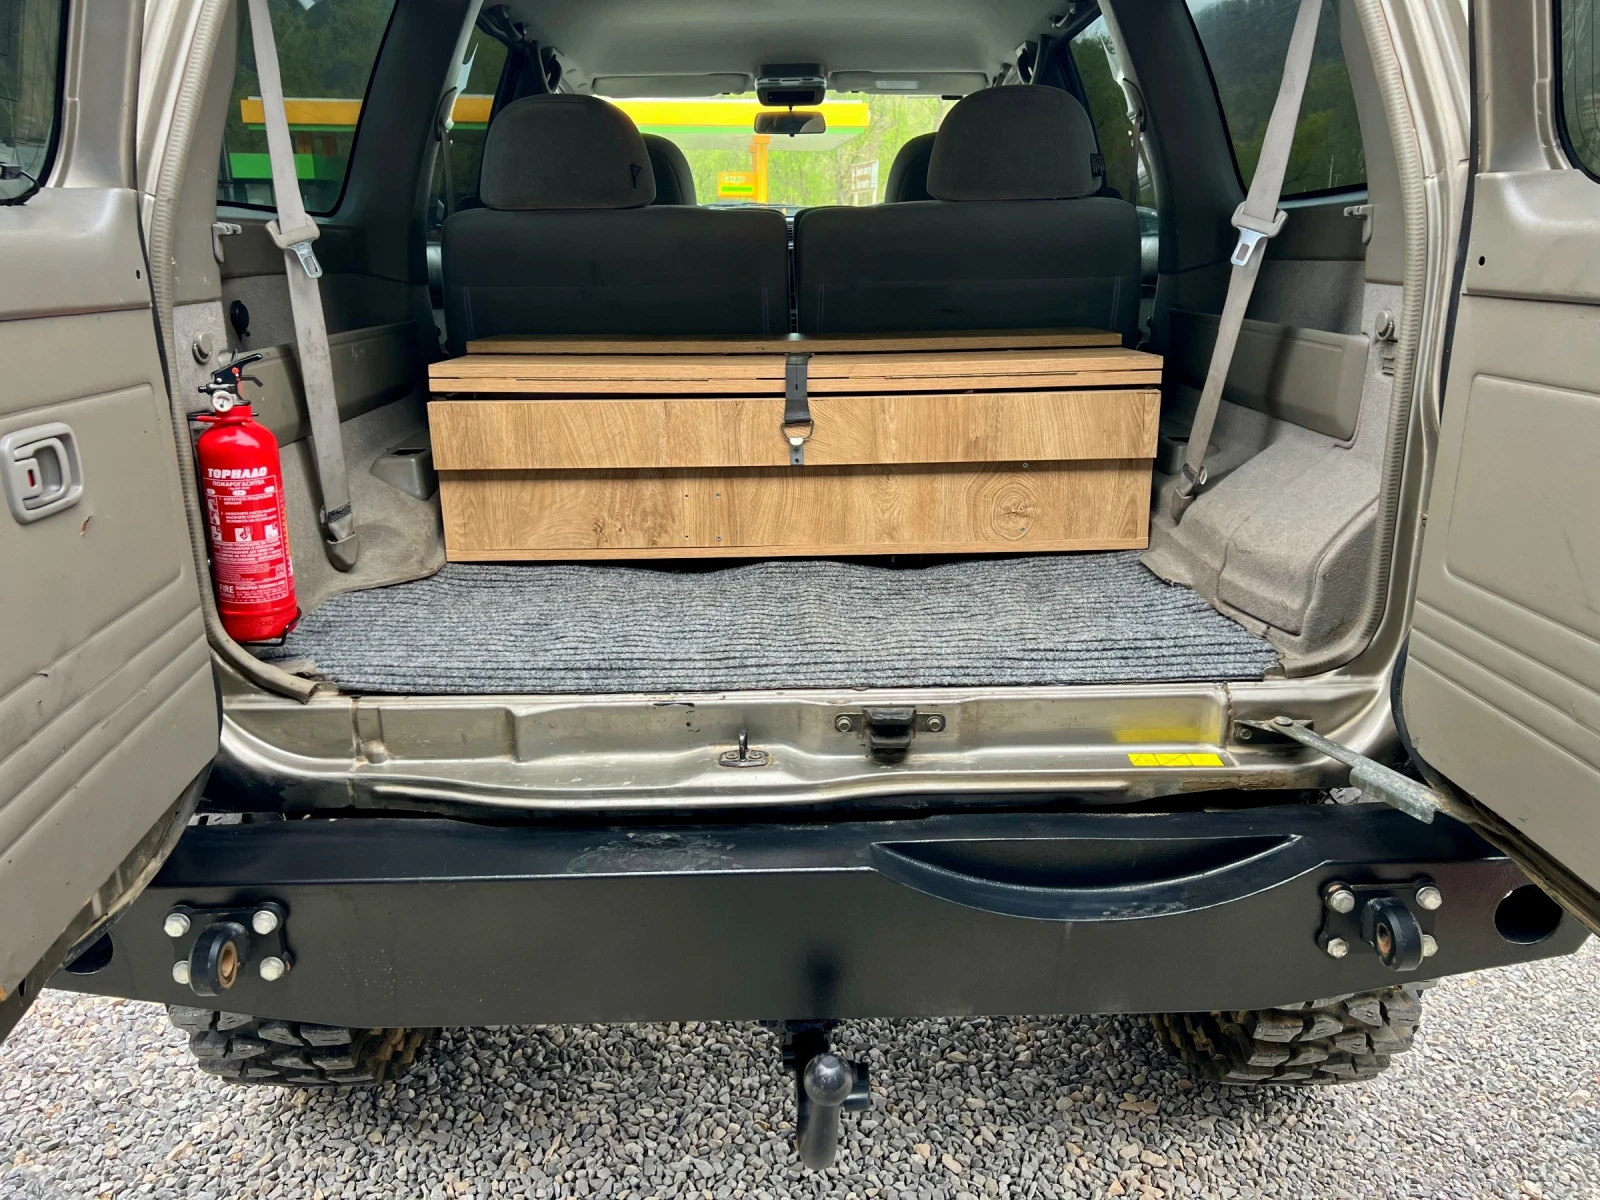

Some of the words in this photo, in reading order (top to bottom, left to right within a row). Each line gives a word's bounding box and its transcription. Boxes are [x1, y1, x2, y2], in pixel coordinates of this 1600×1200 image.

[721, 174, 745, 184] Cargo
[207, 466, 267, 479] ТОРНАДО
[212, 479, 265, 487] ПОЖАРОГАСИТЕЛ
[245, 526, 251, 534] B
[219, 583, 234, 593] FIRE
